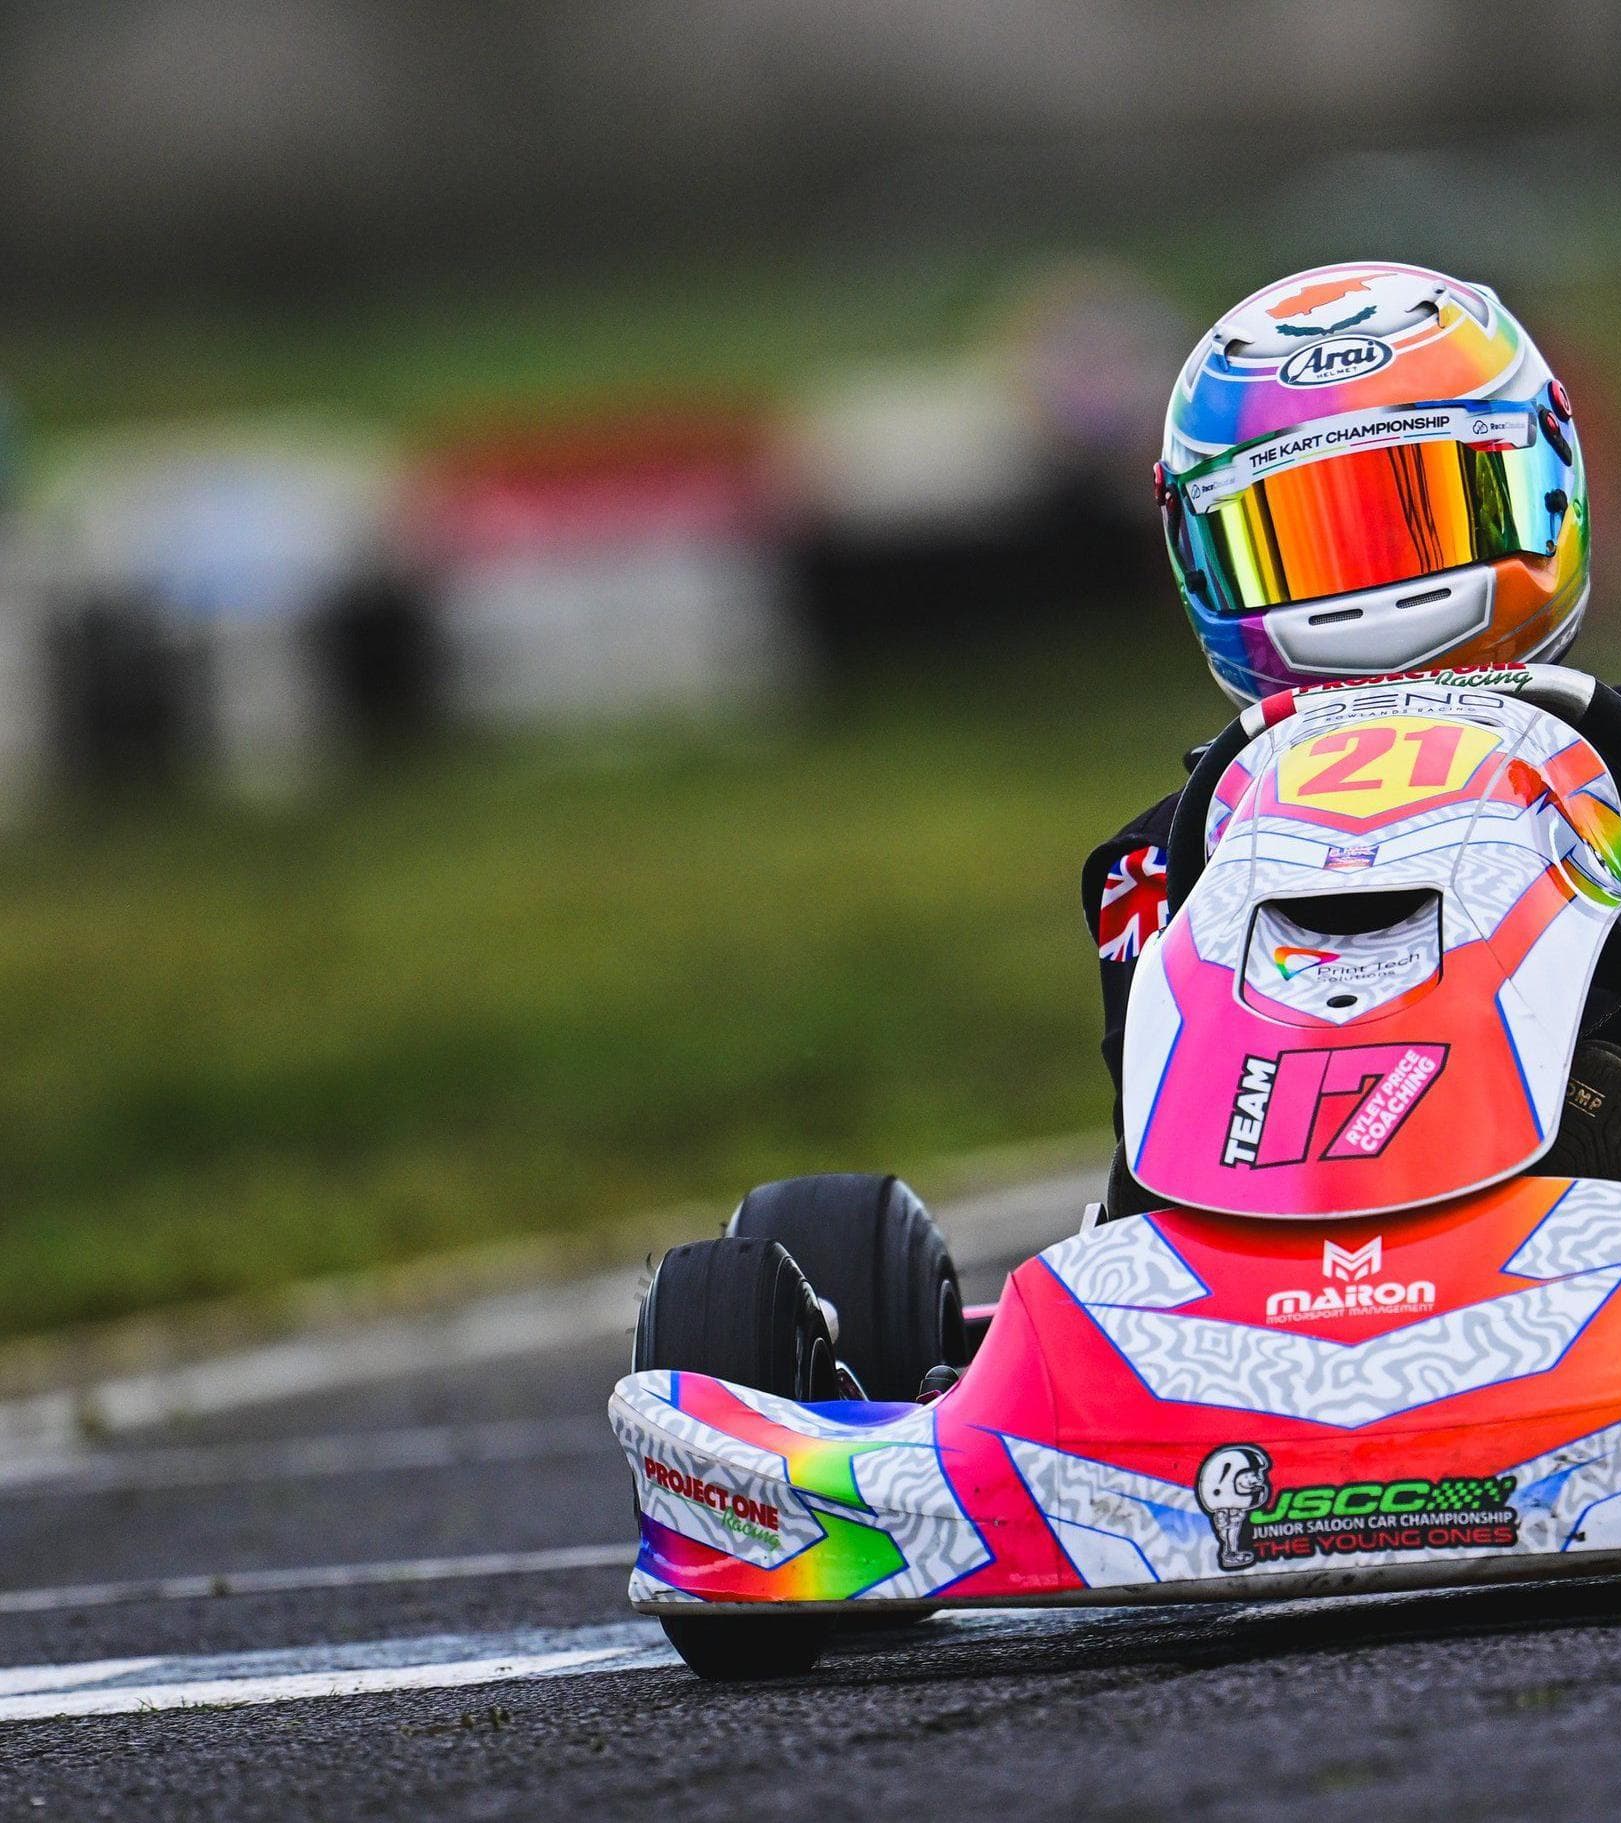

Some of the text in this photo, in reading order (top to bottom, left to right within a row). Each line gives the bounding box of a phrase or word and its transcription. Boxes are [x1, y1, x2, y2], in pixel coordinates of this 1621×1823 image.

[1289, 341, 1376, 382] Arai
[1317, 366, 1358, 378] HELMET
[1250, 416, 1450, 468] THE KART CHAMPIONSHIP
[1435, 671, 1533, 692] Racing
[1297, 725, 1464, 797] 21
[1318, 966, 1367, 976] Print
[1223, 1056, 1278, 1165] TEAM
[1345, 1049, 1420, 1146] RYLEY PRICE
[1360, 1056, 1437, 1152] COACHING
[1266, 1280, 1436, 1316] MARON
[1266, 1302, 1434, 1325] MOTORSPORT MANAGEMENT
[644, 1456, 779, 1531] PROJECT ONE
[1250, 1483, 1430, 1524] JSCC
[721, 1506, 780, 1551] Racing
[1252, 1511, 1513, 1539] JUNIOR SALOON CAR CHAMPIONSHIP
[1253, 1526, 1513, 1559] THE YOUNG ONES
